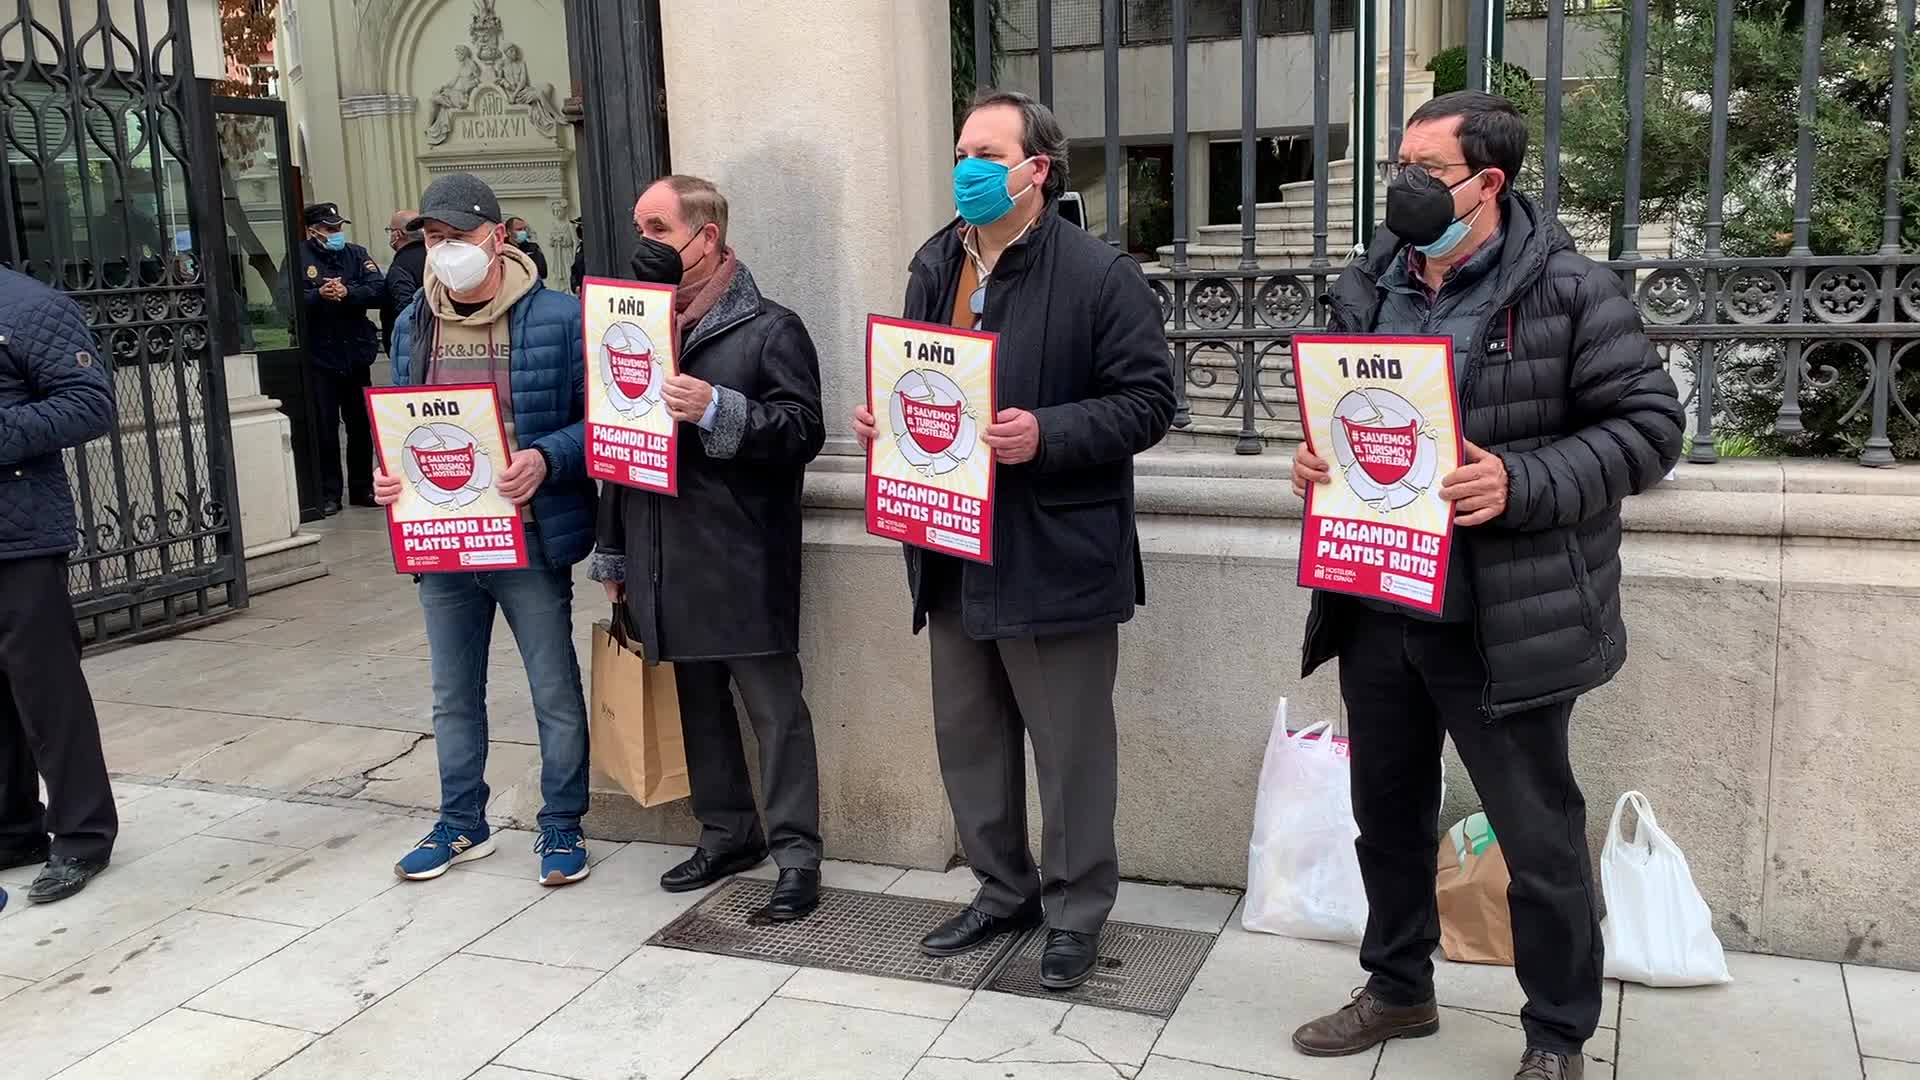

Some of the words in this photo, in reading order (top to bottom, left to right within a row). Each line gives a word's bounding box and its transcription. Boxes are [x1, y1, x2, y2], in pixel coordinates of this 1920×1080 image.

[462, 118, 527, 139] MCMXVI
[608, 297, 614, 313] 1
[618, 296, 645, 316] AÑO
[904, 341, 912, 358] 1
[918, 341, 955, 365] AÑO
[1338, 357, 1349, 378] 1
[1356, 354, 1403, 379] AÑO
[406, 402, 416, 417] 1
[422, 398, 460, 417] AÑO
[906, 404, 957, 423] #SALVEMOS
[915, 416, 951, 431] TURISMO
[593, 425, 645, 448] PAGANDO
[647, 436, 668, 452] LOS
[1352, 430, 1412, 446] #SALVEMOS
[420, 454, 470, 464] #SALVEMOS
[593, 443, 630, 461] PLATOS
[633, 450, 668, 468] ROTOS
[1354, 445, 1364, 453] EL
[1362, 443, 1406, 457] TURISMO
[1406, 448, 1412, 459] Y
[430, 462, 466, 471] TURISMO
[878, 479, 949, 508] PAGANDO
[953, 497, 981, 517] LOS
[877, 499, 929, 522] PLATOS
[933, 511, 980, 534] ROTOS
[402, 520, 479, 536] PAGANDO
[483, 518, 512, 533] LOS
[404, 536, 460, 551] PLATOS
[464, 534, 514, 549] ROTOS
[1319, 519, 1408, 550] PAGANDO
[1412, 534, 1441, 557] LOS
[1317, 540, 1385, 566] PLATOS
[1389, 550, 1437, 578] ROTOS
